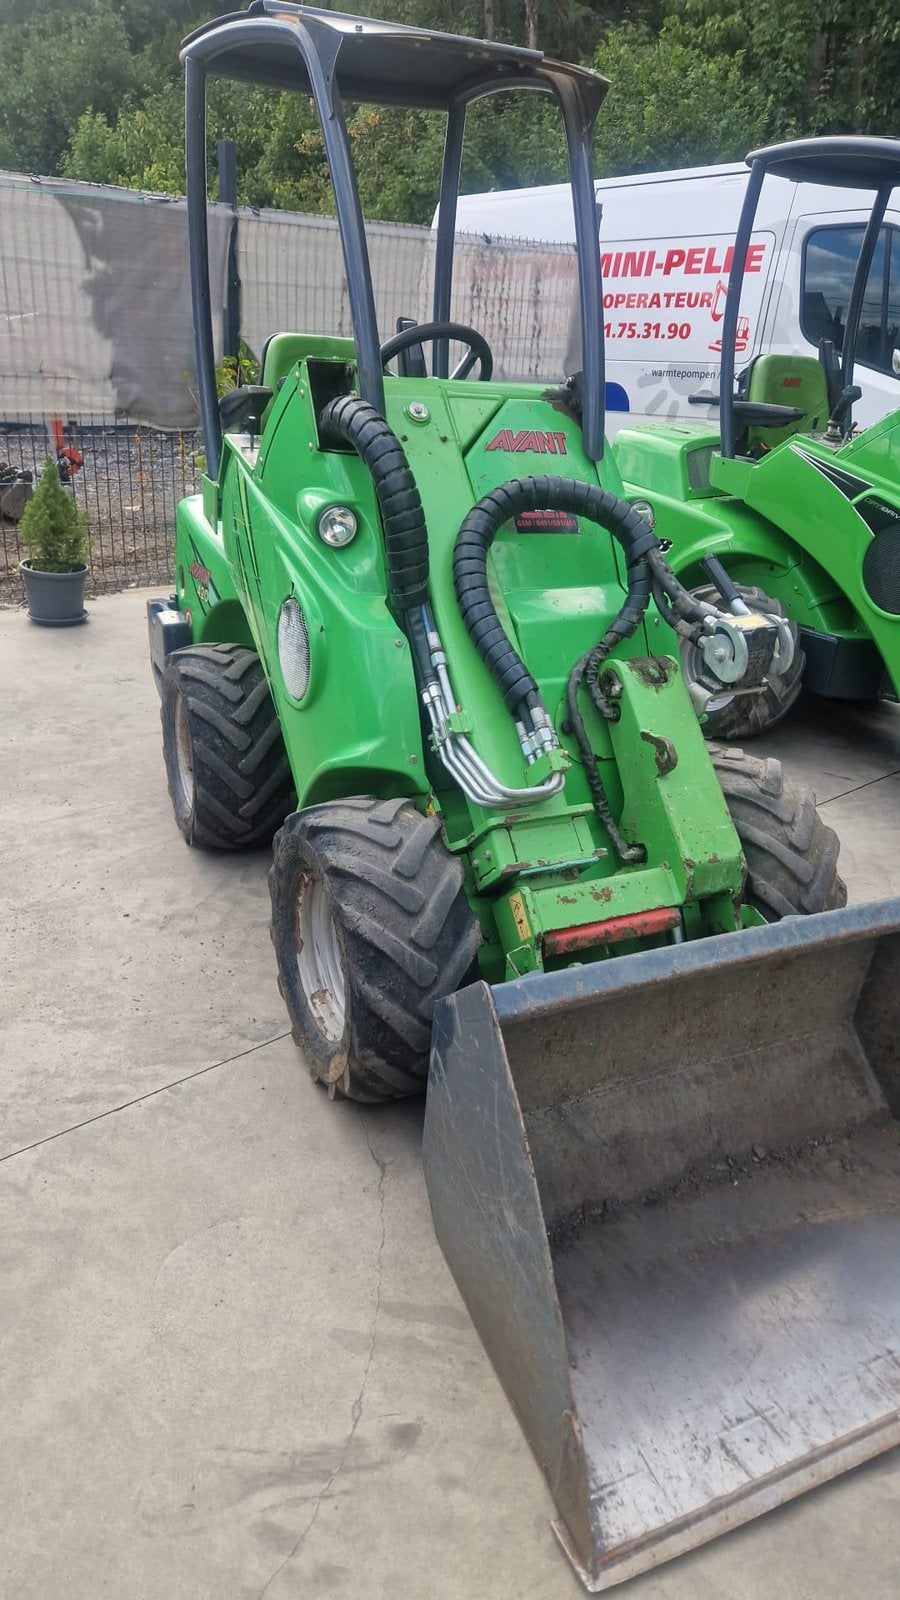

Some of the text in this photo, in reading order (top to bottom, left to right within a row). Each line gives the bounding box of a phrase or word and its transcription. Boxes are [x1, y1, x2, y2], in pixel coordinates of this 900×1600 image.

[603, 291, 714, 309] OPERATEUR
[604, 322, 692, 340] 1.75.31.90
[651, 368, 716, 381] warmtepompen
[485, 428, 568, 455] AVANT
